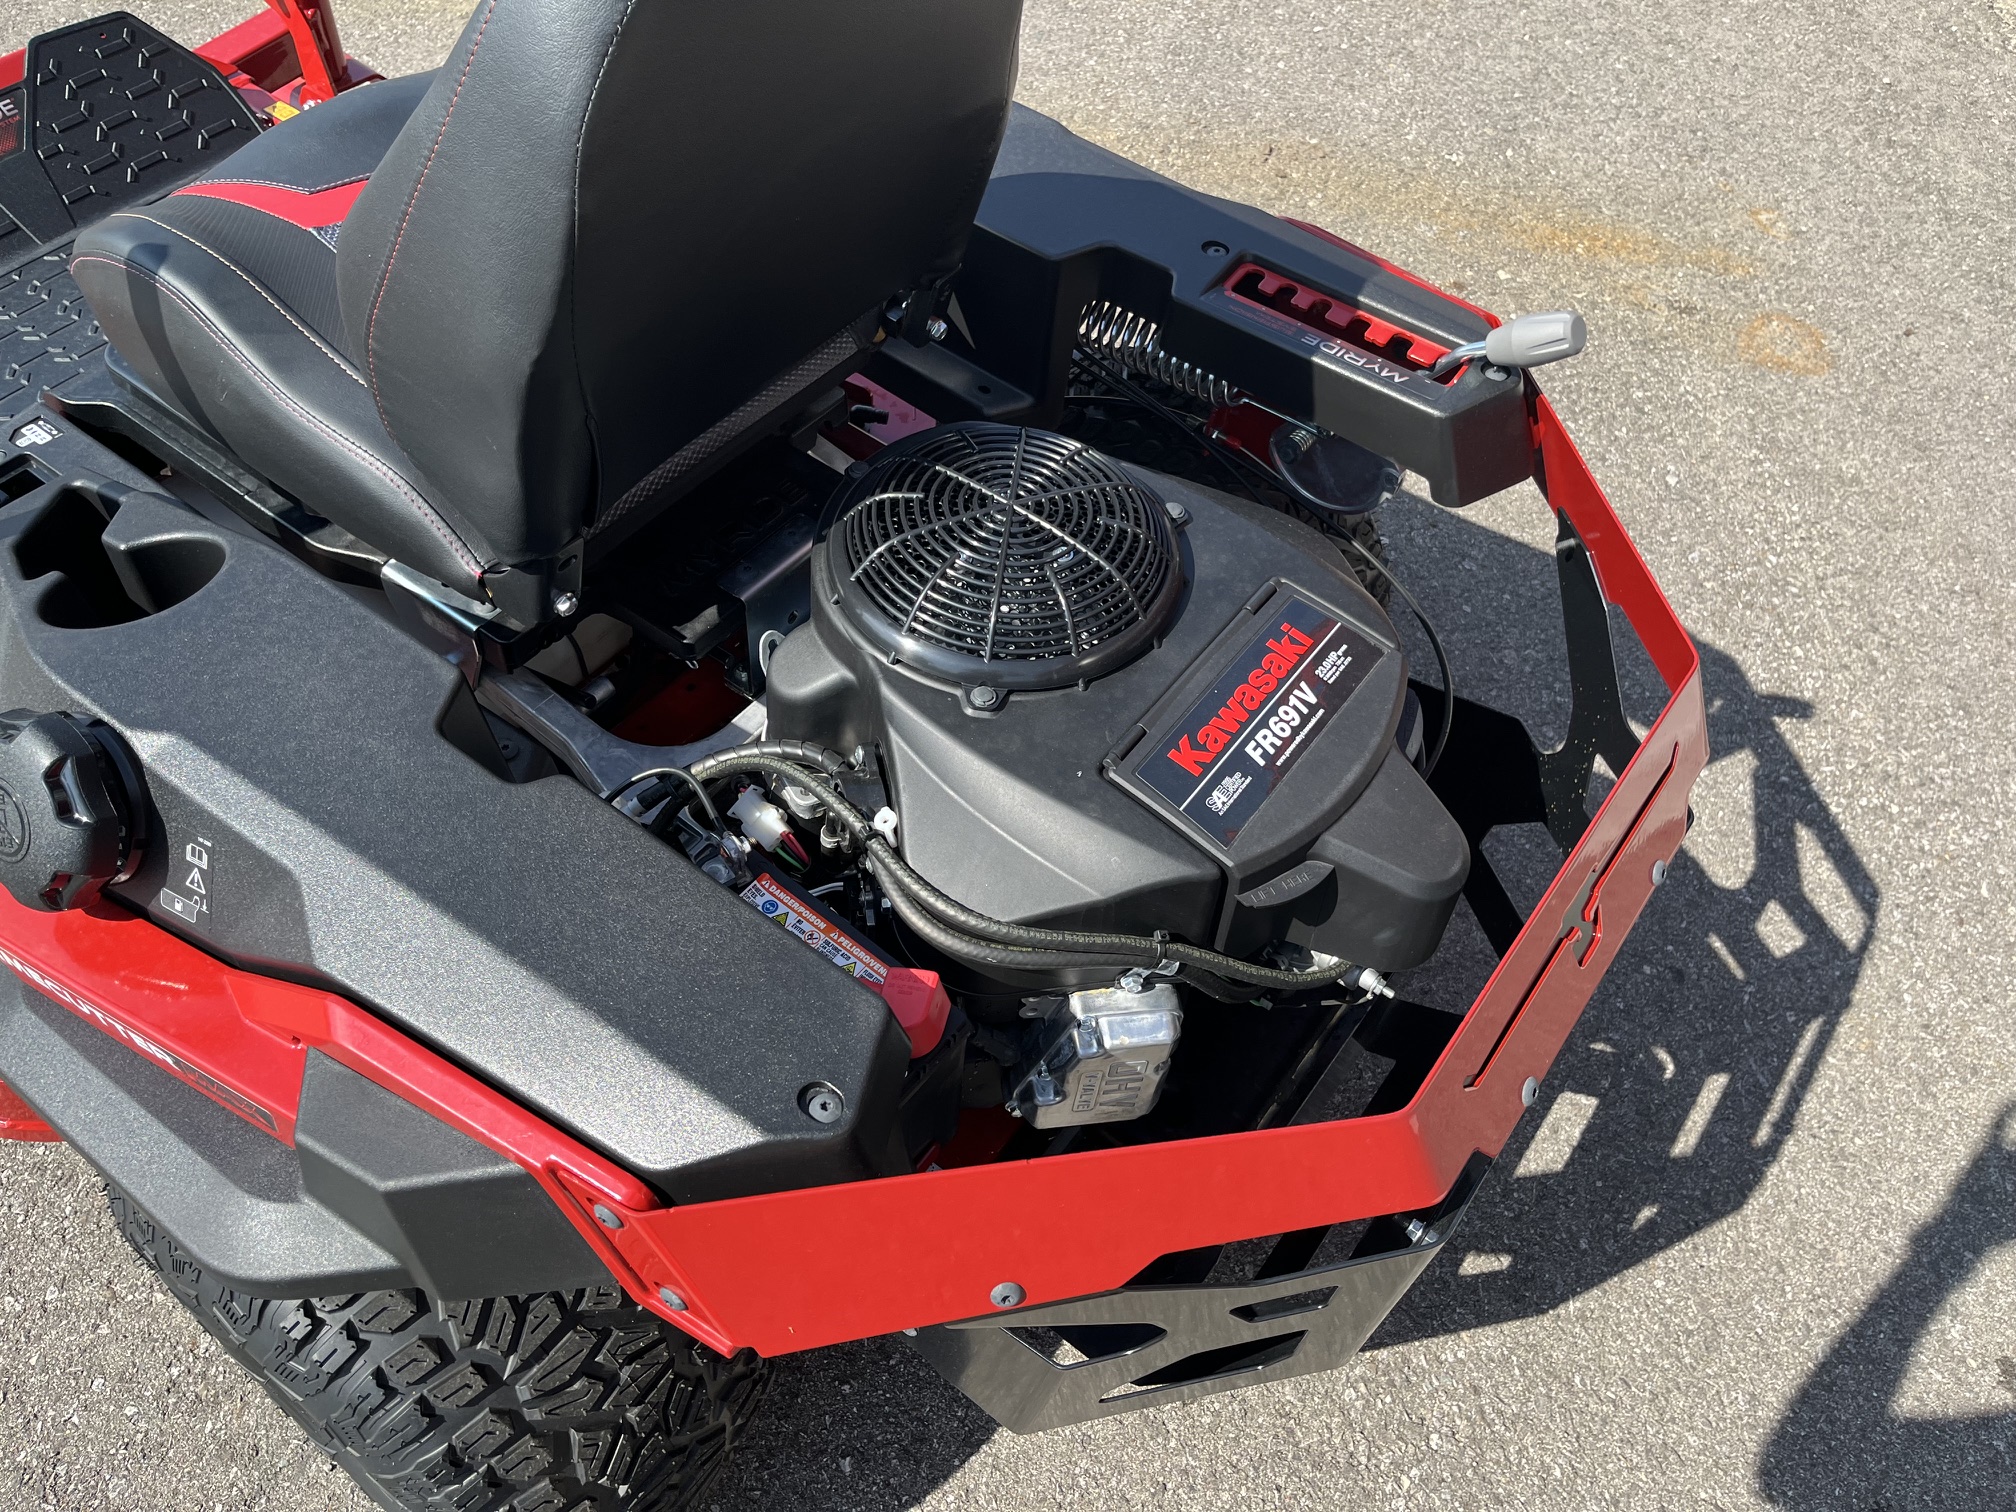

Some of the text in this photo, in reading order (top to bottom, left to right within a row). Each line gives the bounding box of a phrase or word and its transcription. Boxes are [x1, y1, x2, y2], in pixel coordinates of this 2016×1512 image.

[1167, 622, 1314, 777] Kawasaki
[1244, 681, 1318, 767] FR691V
[752, 884, 766, 898] SHIELD
[769, 885, 827, 930] DANGER/POISON
[1250, 871, 1314, 903] LIFT HERE
[840, 952, 851, 962] ACID
[0, 951, 181, 1071] MECUTTER
[1099, 1060, 1149, 1107] OHV
